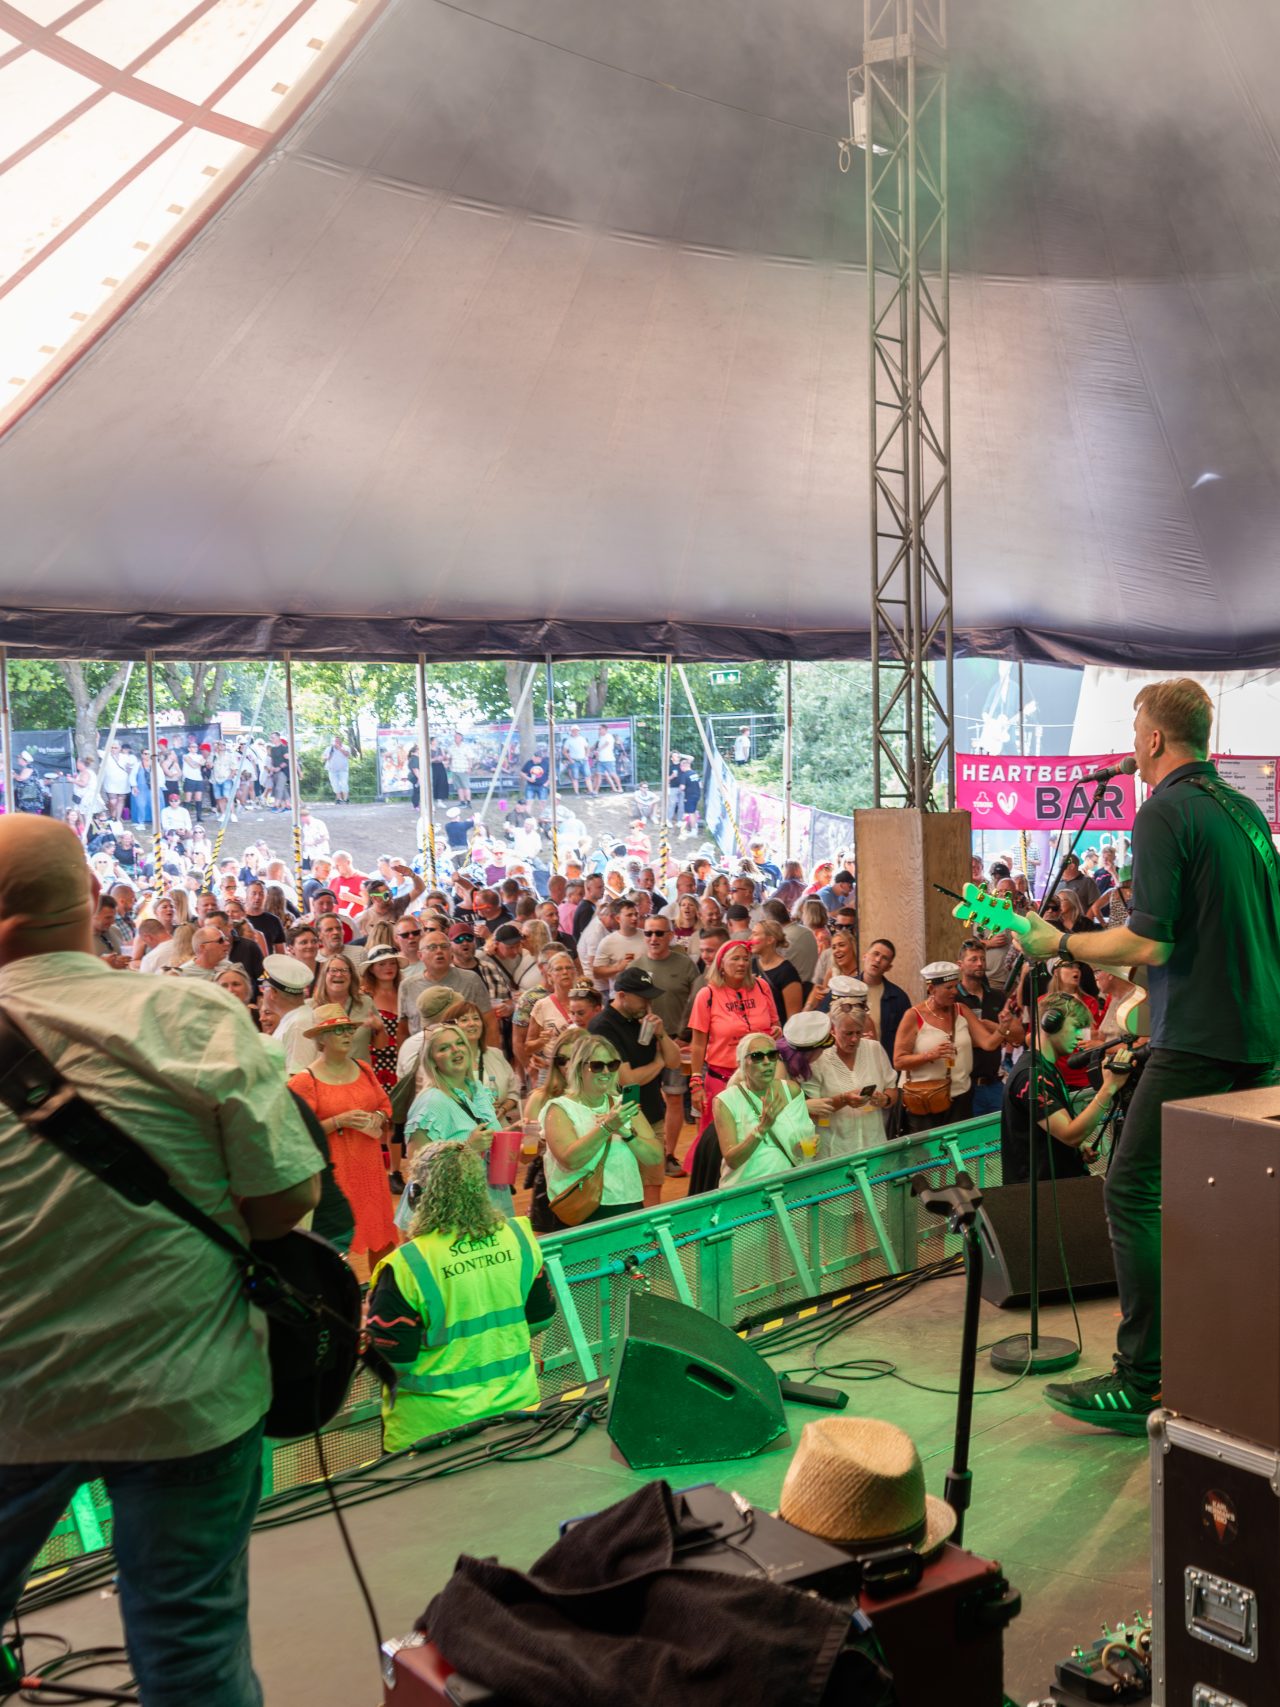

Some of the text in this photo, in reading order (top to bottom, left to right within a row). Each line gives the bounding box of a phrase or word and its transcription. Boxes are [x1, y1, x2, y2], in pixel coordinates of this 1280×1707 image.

[962, 764, 1099, 782] HEARTBEAT
[1035, 786, 1125, 820] BAR
[449, 1234, 499, 1257] SCENE
[441, 1250, 515, 1280] KONTROL
